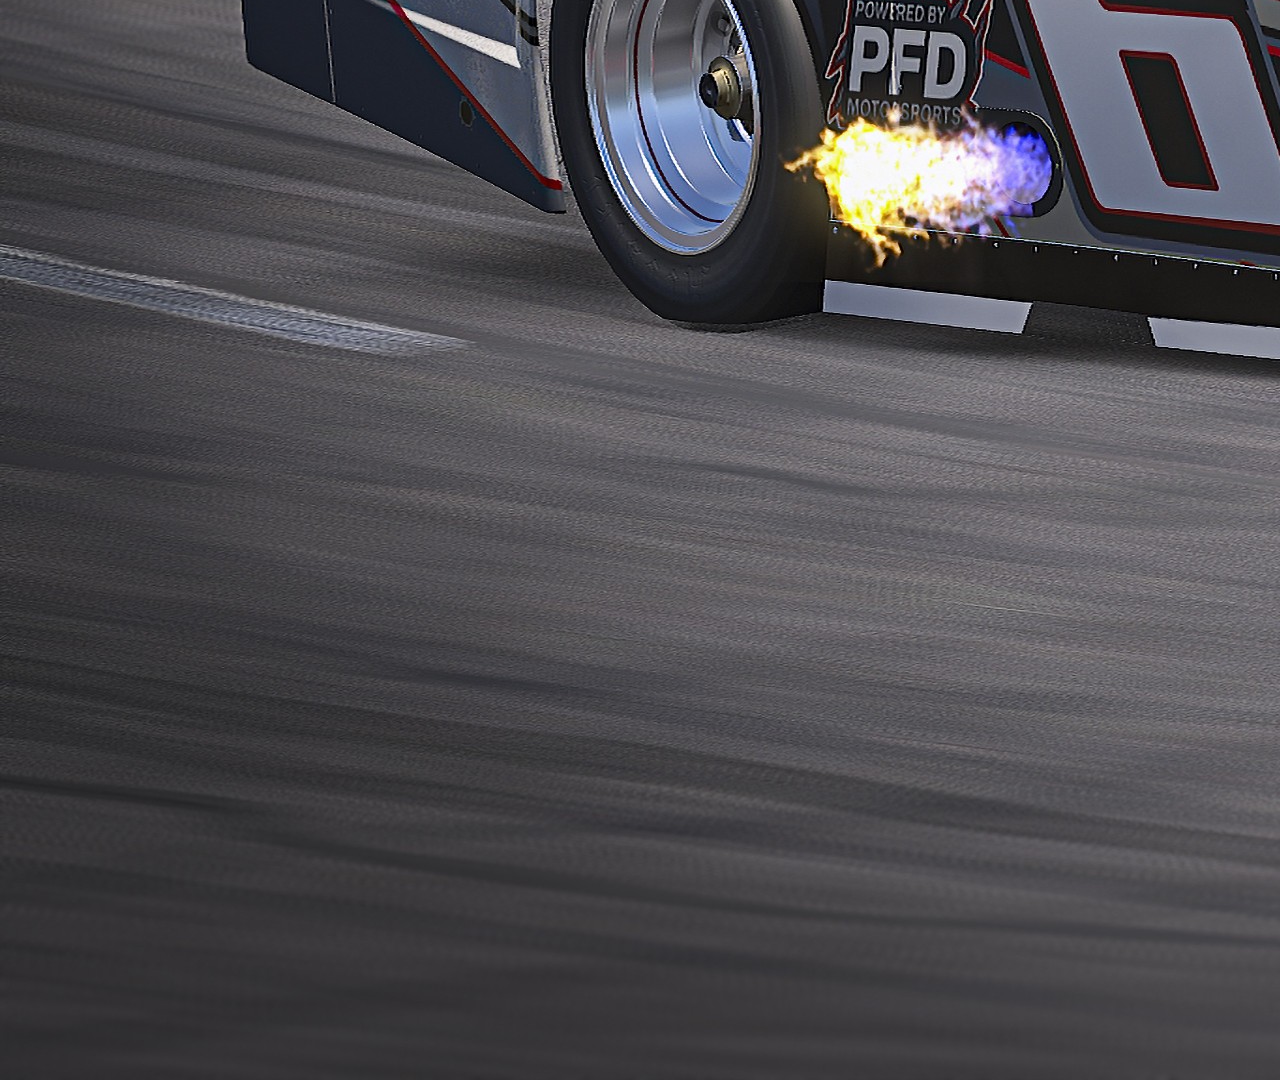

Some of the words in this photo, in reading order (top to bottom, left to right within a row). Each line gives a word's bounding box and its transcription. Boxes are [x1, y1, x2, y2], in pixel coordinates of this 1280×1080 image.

[855, 0, 924, 23] POWERED
[929, 5, 946, 24] BY
[849, 25, 966, 100] PFD
